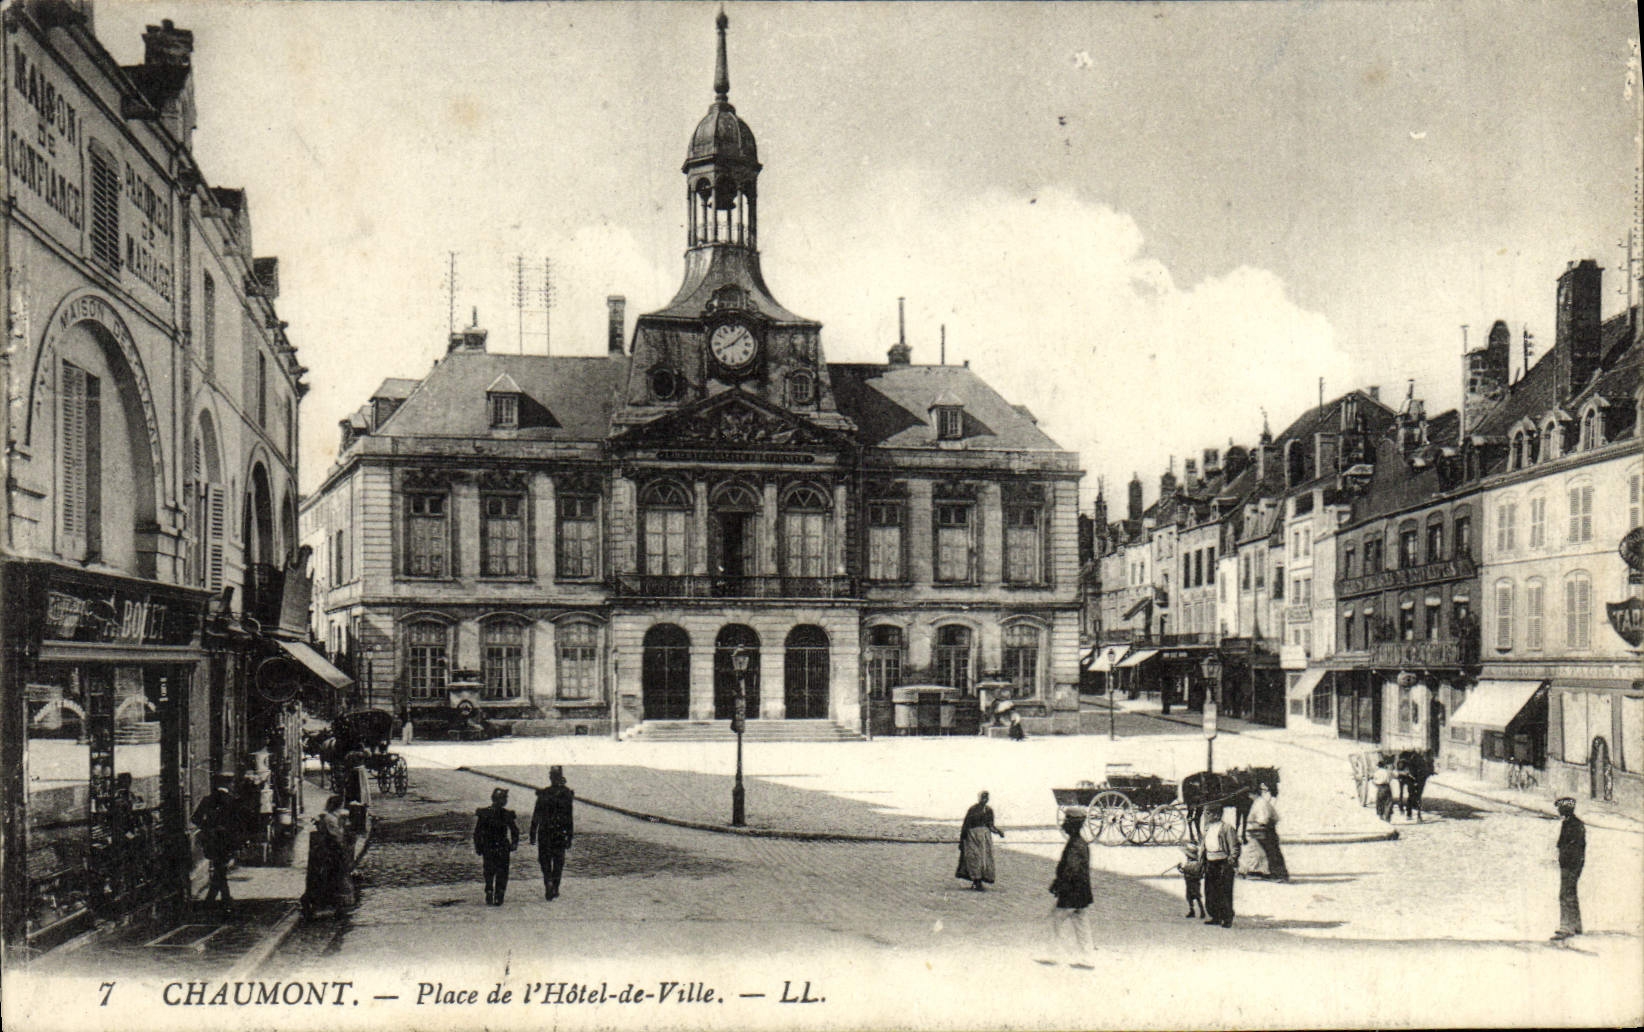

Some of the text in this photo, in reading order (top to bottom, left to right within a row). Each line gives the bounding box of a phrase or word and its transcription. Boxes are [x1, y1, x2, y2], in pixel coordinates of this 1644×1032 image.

[14, 43, 76, 146] MAISON
[38, 123, 56, 158] DE
[11, 130, 81, 230] CONFIANCE
[60, 299, 105, 330] MAISON
